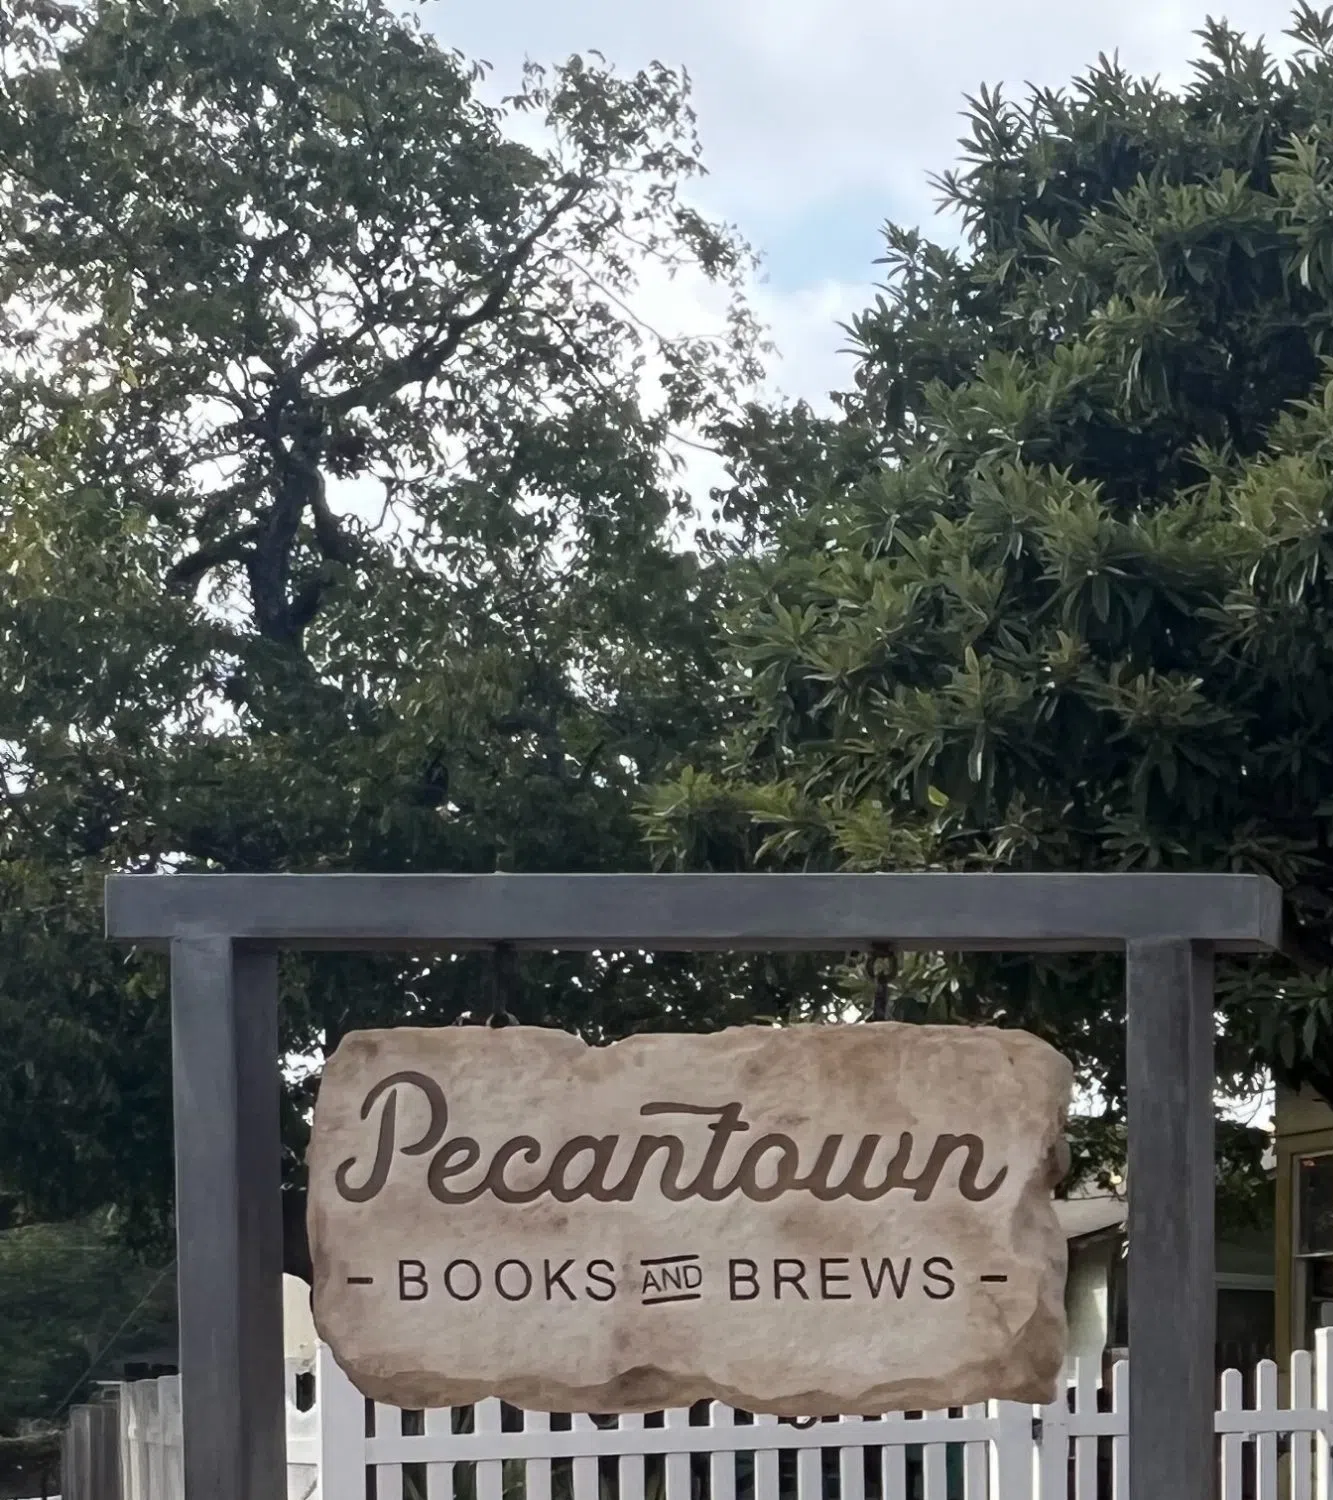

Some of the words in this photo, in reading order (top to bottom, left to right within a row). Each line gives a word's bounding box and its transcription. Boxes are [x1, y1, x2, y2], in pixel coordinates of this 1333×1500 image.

[335, 1069, 1009, 1204] Pecantown
[399, 1257, 617, 1302] BOOKS
[641, 1259, 703, 1296] AND
[729, 1256, 956, 1301] BREWS
